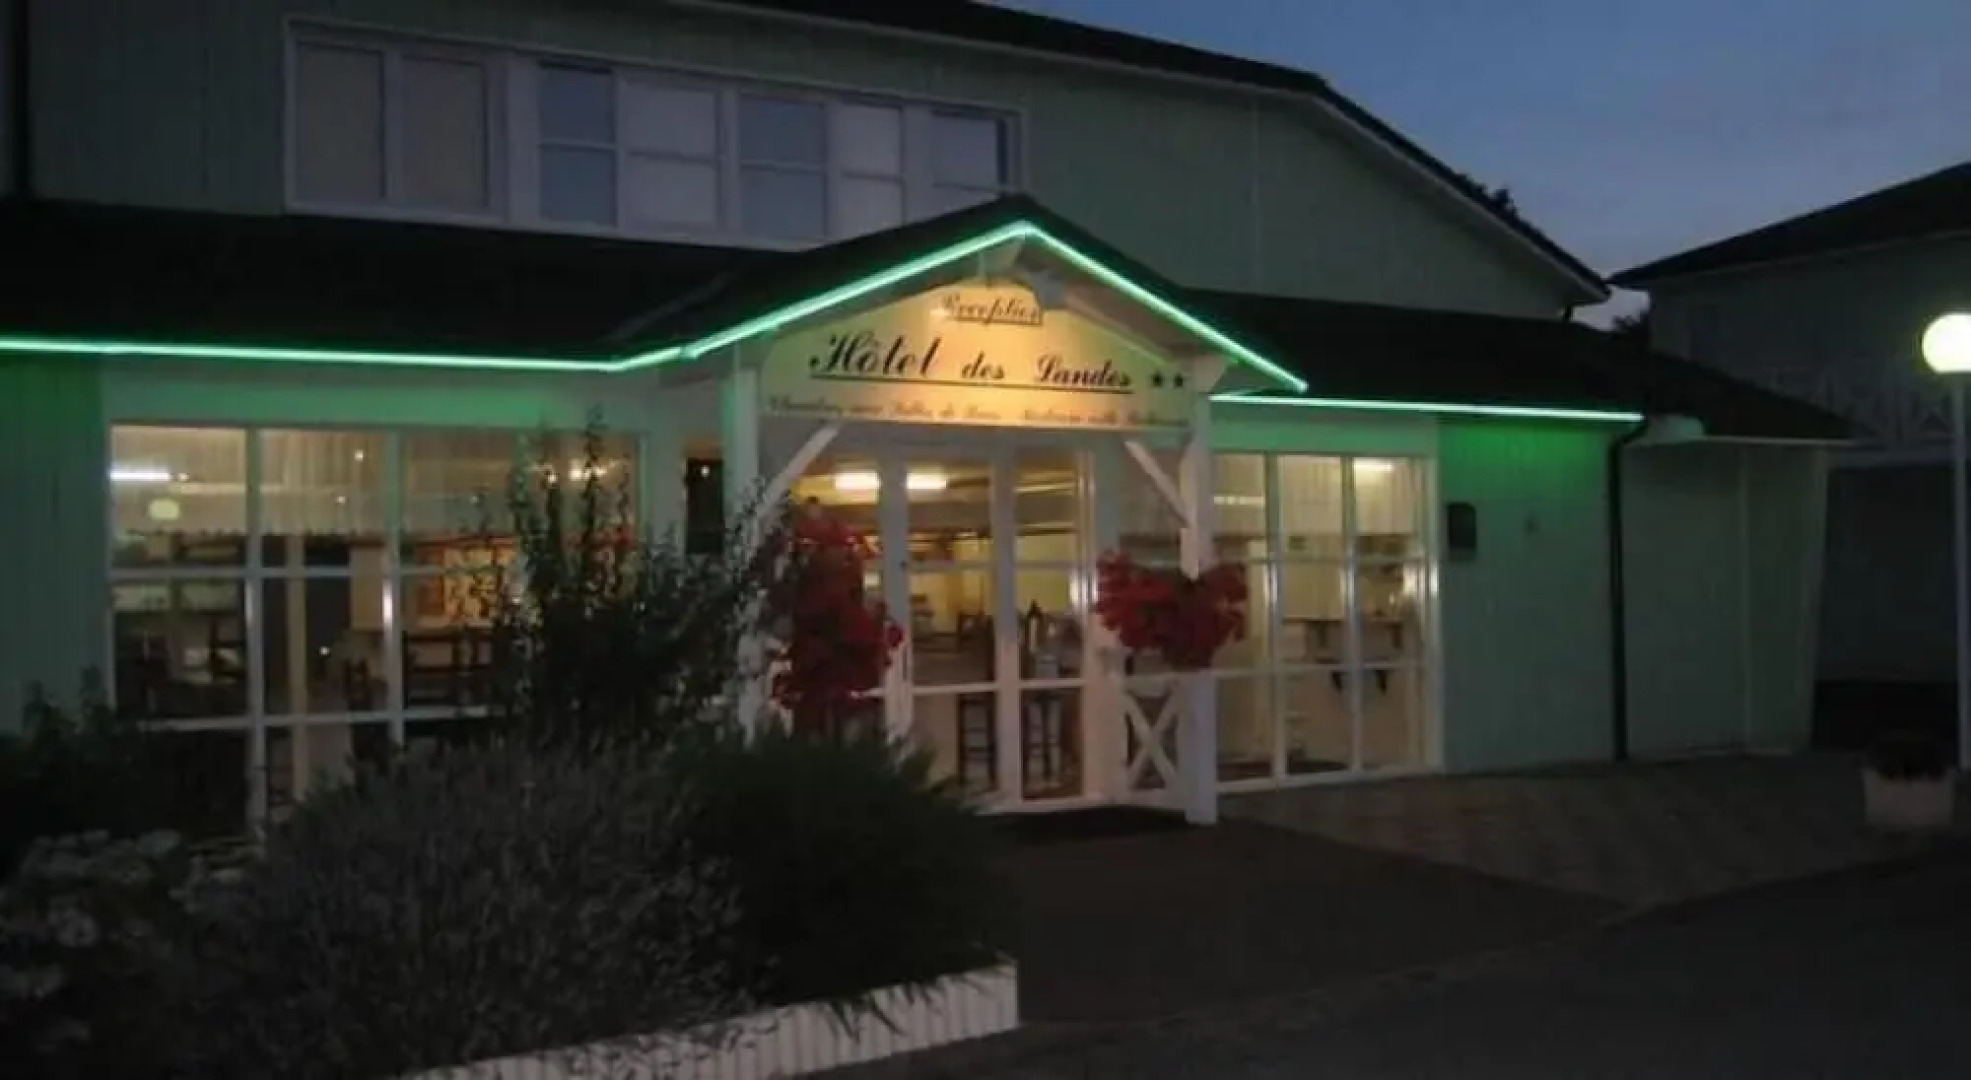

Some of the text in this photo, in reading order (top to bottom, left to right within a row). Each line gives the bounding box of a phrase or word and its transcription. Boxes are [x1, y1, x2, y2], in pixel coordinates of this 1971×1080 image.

[810, 333, 1132, 388] Hôtel des Landes
